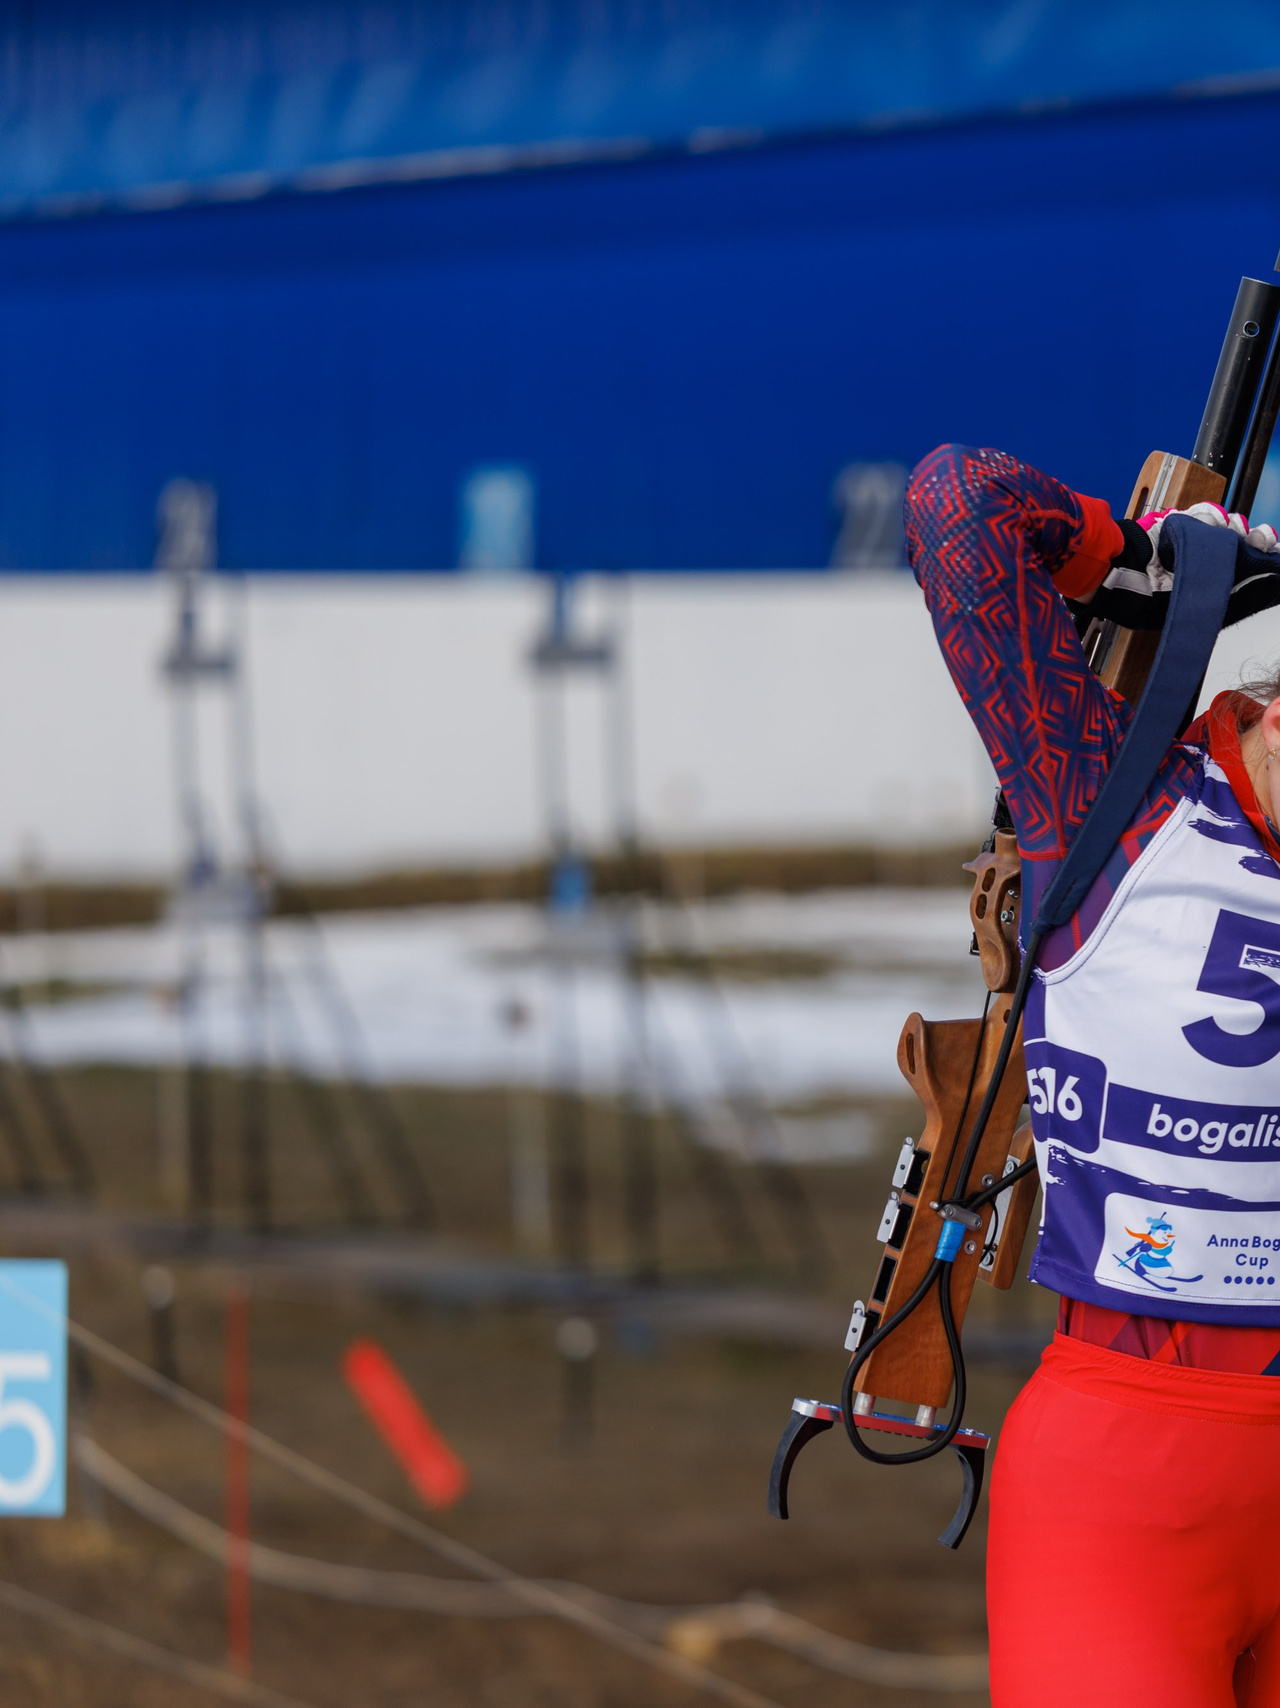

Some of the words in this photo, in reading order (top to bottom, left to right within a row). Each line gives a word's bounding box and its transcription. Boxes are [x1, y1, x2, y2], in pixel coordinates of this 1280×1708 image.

[1026, 1066, 1083, 1121] 516
[1206, 1234, 1249, 1248] Anna
[1235, 1253, 1269, 1270] Cup
